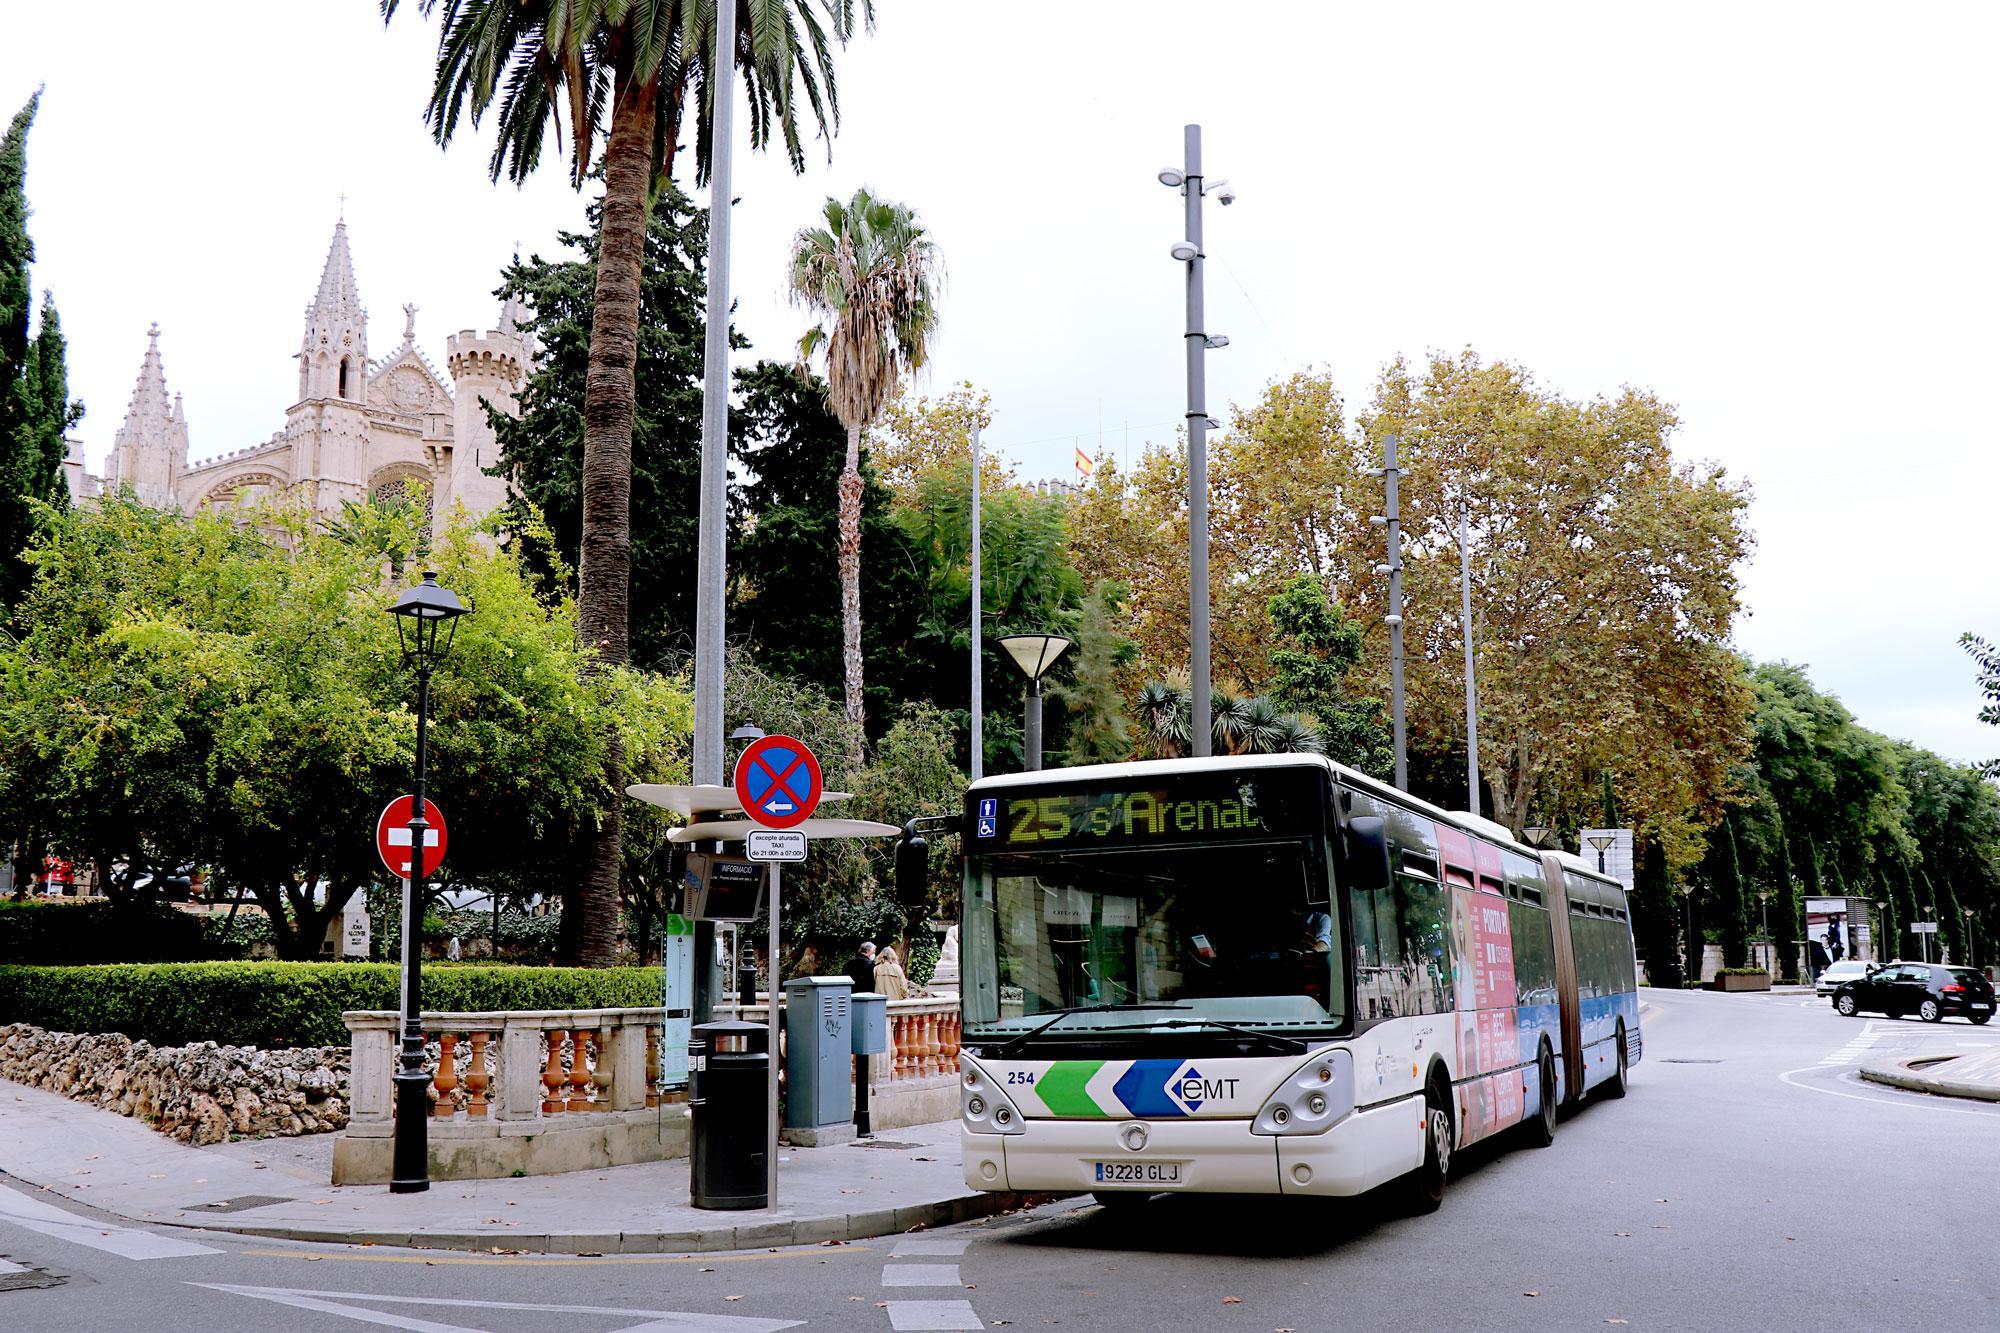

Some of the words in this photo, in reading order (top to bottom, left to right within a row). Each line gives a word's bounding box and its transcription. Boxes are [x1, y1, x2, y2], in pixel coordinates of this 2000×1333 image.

[1009, 797, 1070, 841] 25
[1090, 792, 1258, 836] s'Arenal
[1008, 1072, 1035, 1085] 254
[1105, 1165, 1143, 1181] 9228
[1148, 1165, 1178, 1181] GLJ
